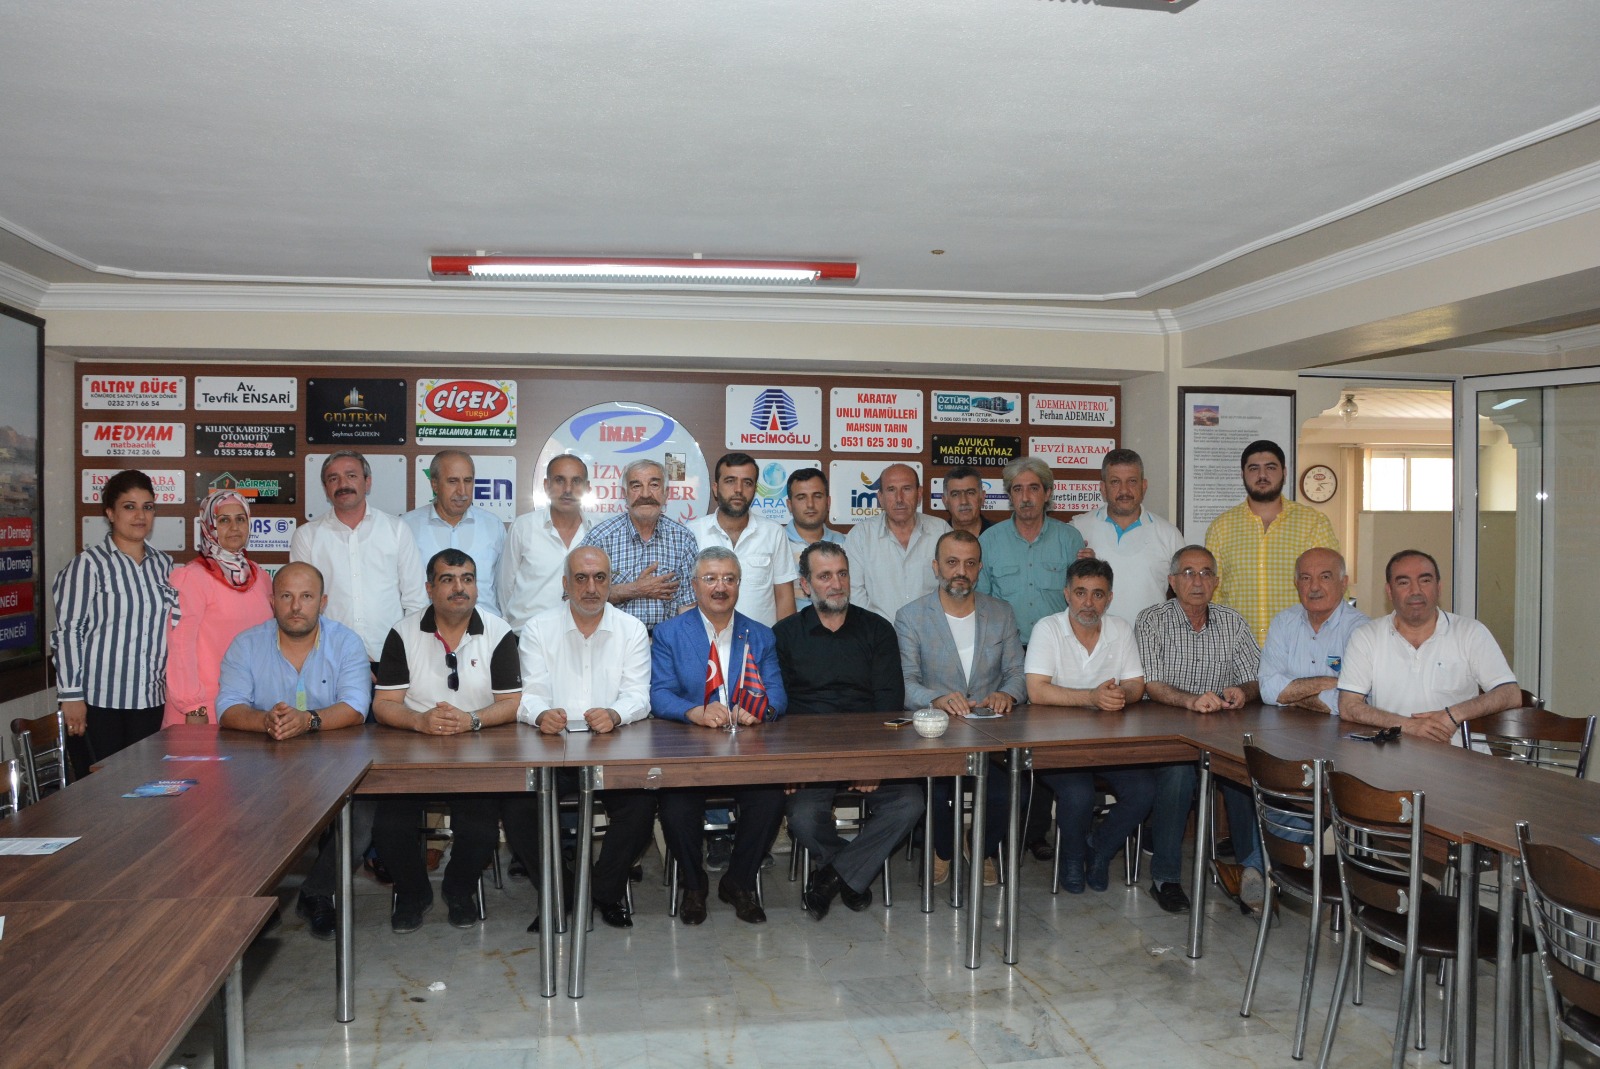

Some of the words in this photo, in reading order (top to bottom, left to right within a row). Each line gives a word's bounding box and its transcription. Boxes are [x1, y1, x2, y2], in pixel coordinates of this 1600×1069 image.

[91, 380, 135, 393] ALTAY
[140, 378, 177, 393] BÜFE
[236, 382, 256, 392] Av.
[202, 393, 238, 403] Tevfik
[242, 391, 290, 403] ENSARİ
[433, 386, 500, 413] ÇİÇEK
[857, 393, 898, 405] KARATAY
[937, 396, 970, 404] ÖZTÜRK
[1036, 399, 1077, 410] ADEMHAN
[1078, 401, 1109, 411] PETROL
[465, 410, 489, 418] TURŞU
[836, 408, 861, 418] UNLU
[863, 407, 918, 420] MAMÜLLERİ
[1039, 410, 1064, 420] Ferhan
[1064, 411, 1105, 422] ADEMHAN
[94, 424, 173, 441] MEDYAM
[205, 425, 235, 434] KILINÇ
[236, 426, 286, 435] KARDEŞLER
[418, 426, 438, 437] ÇİÇEK
[439, 428, 473, 437] SALAMURA
[474, 428, 488, 436] SAN.
[502, 428, 515, 438] A.Ş.
[599, 422, 647, 442] İMAF
[846, 423, 882, 433] MAHSUN
[884, 424, 908, 433] TARIN
[221, 433, 270, 441] OTOMOTİV
[740, 432, 811, 445] NECİMOĞLU
[841, 437, 864, 447] 0531
[867, 437, 884, 448] 625
[887, 438, 898, 448] 30
[901, 438, 913, 448] 90
[957, 438, 995, 447] AVUKAT
[939, 445, 972, 455] MARUF
[975, 447, 1013, 456] KAYMAZ
[1034, 443, 1065, 453] FEVZİ
[1067, 445, 1110, 454] BAYRAM
[943, 456, 965, 465] 0506
[967, 457, 982, 465] 351
[985, 457, 996, 465] 00
[998, 457, 1009, 466] 00
[1056, 456, 1088, 465] ECZACI
[593, 462, 627, 480] İZM
[150, 476, 176, 486] ABA
[239, 478, 279, 487] AĞIRMAN
[92, 492, 99, 502] 0
[162, 493, 175, 501] 89
[260, 489, 279, 497] YAPI
[1053, 493, 1077, 501] urettin
[1078, 491, 1102, 501] BEDİR
[751, 498, 786, 508] ARA
[851, 490, 881, 508] im
[851, 507, 885, 516] LOGIST
[250, 519, 271, 534] AŞ
[8, 525, 32, 541] Derneği
[7, 556, 32, 572] Derneği
[0, 592, 18, 608] NEĞİ
[0, 621, 27, 641] ERNEĞİ
